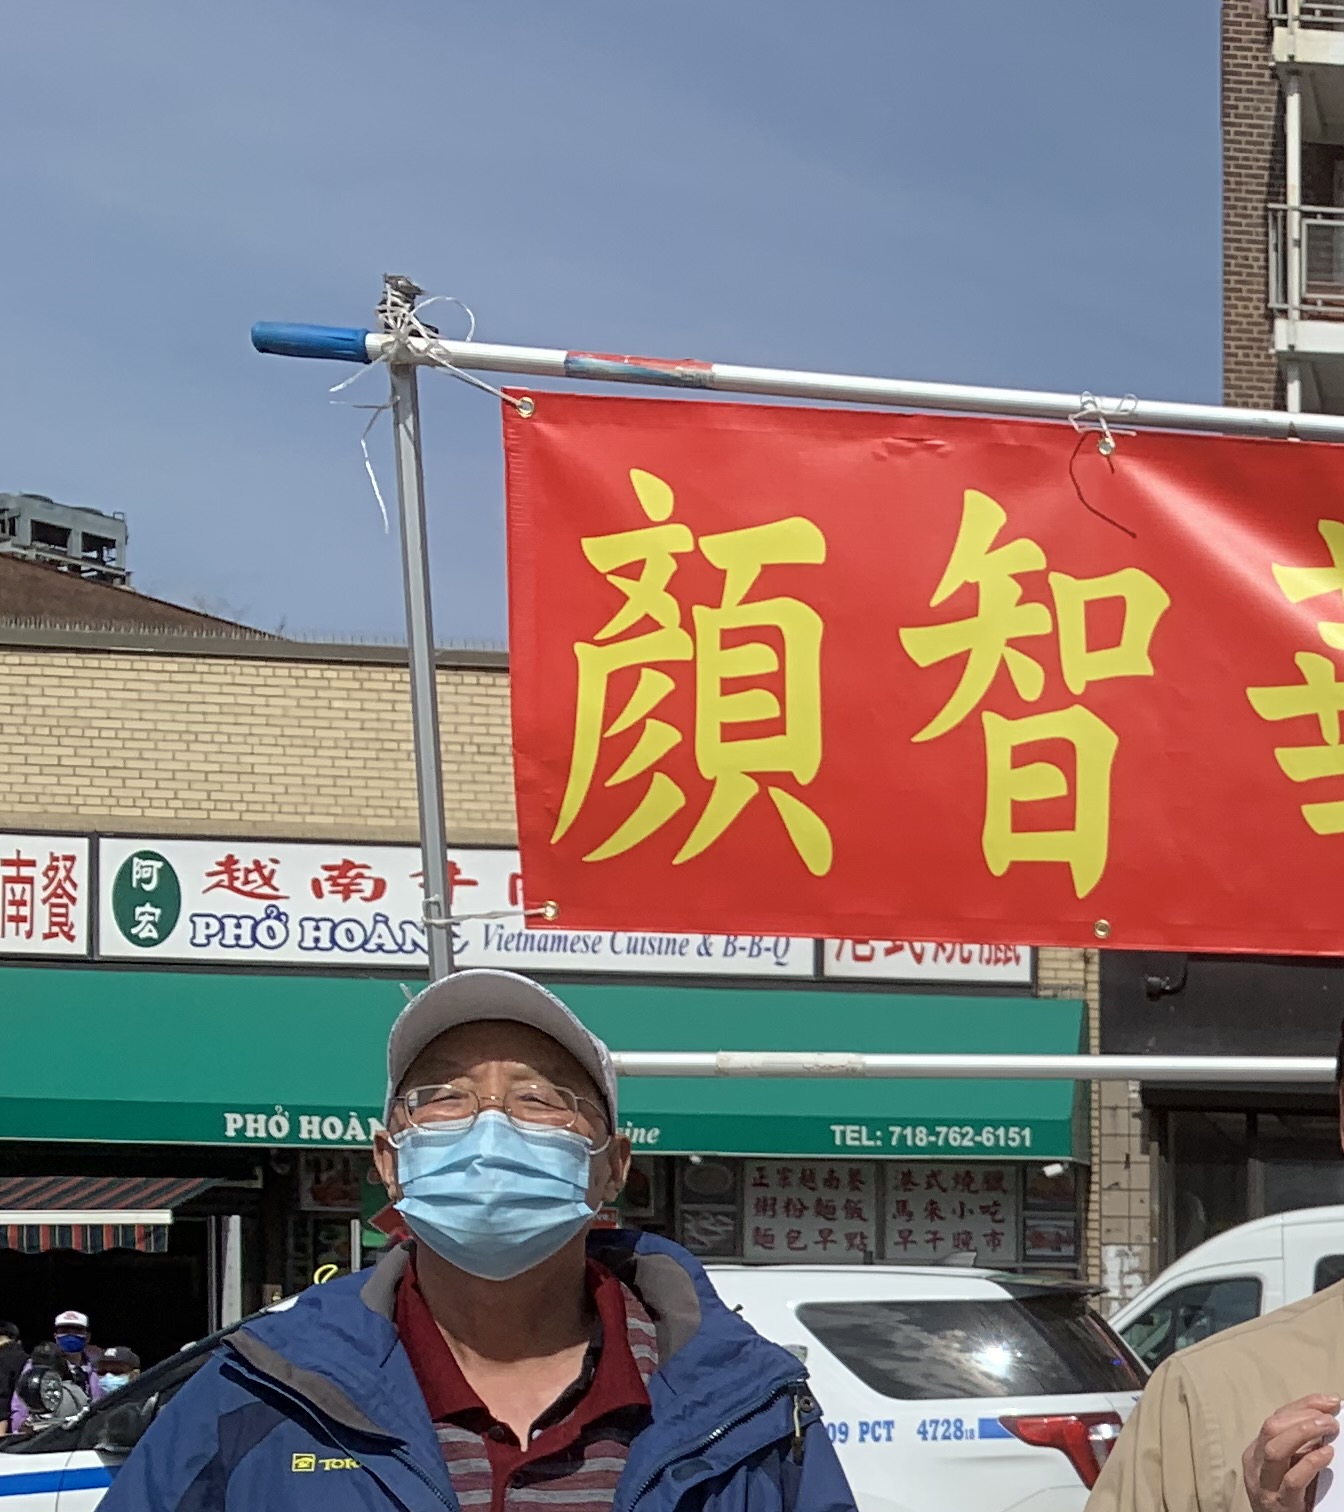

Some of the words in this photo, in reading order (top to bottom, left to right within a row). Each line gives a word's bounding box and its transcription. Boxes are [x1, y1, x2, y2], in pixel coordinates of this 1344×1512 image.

[131, 857, 163, 941] 阿宏
[482, 923, 602, 957] Vietnamese
[609, 931, 689, 958] Cuisine
[696, 937, 714, 957] &
[723, 937, 791, 966] B-B-Q
[831, 1125, 883, 1147] TEL:
[890, 1125, 1032, 1148] 718-762-6151
[858, 1420, 895, 1443] PCT
[916, 1417, 963, 1441] 4728
